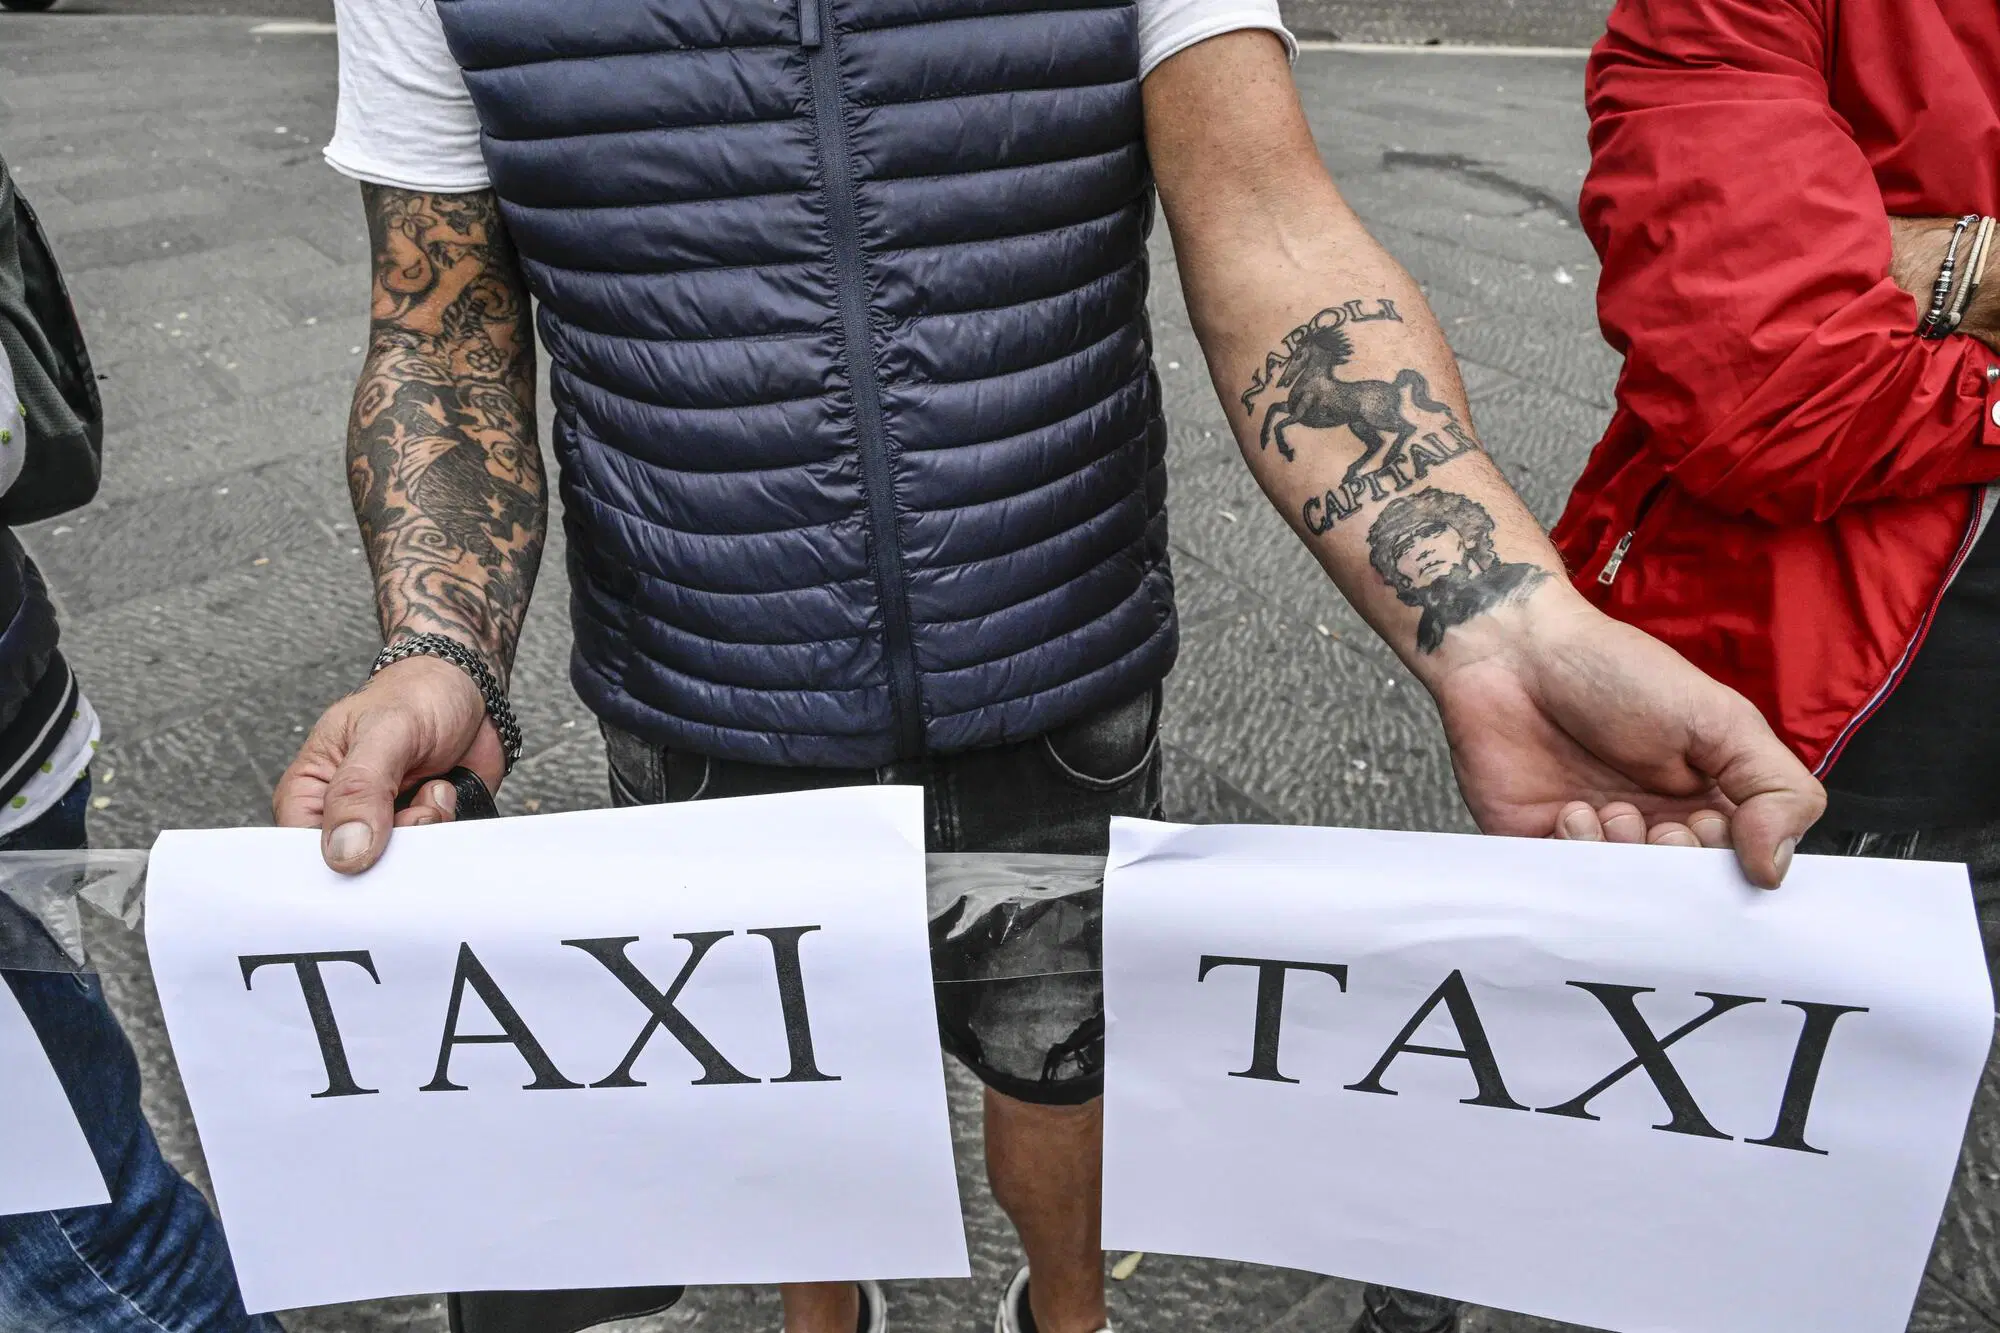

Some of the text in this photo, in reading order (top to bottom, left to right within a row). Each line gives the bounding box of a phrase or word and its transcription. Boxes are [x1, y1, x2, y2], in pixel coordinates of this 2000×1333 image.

[1240, 298, 1403, 416] NAPOLI
[238, 926, 842, 1099] TAXI
[1198, 955, 1870, 1156] TAXI
